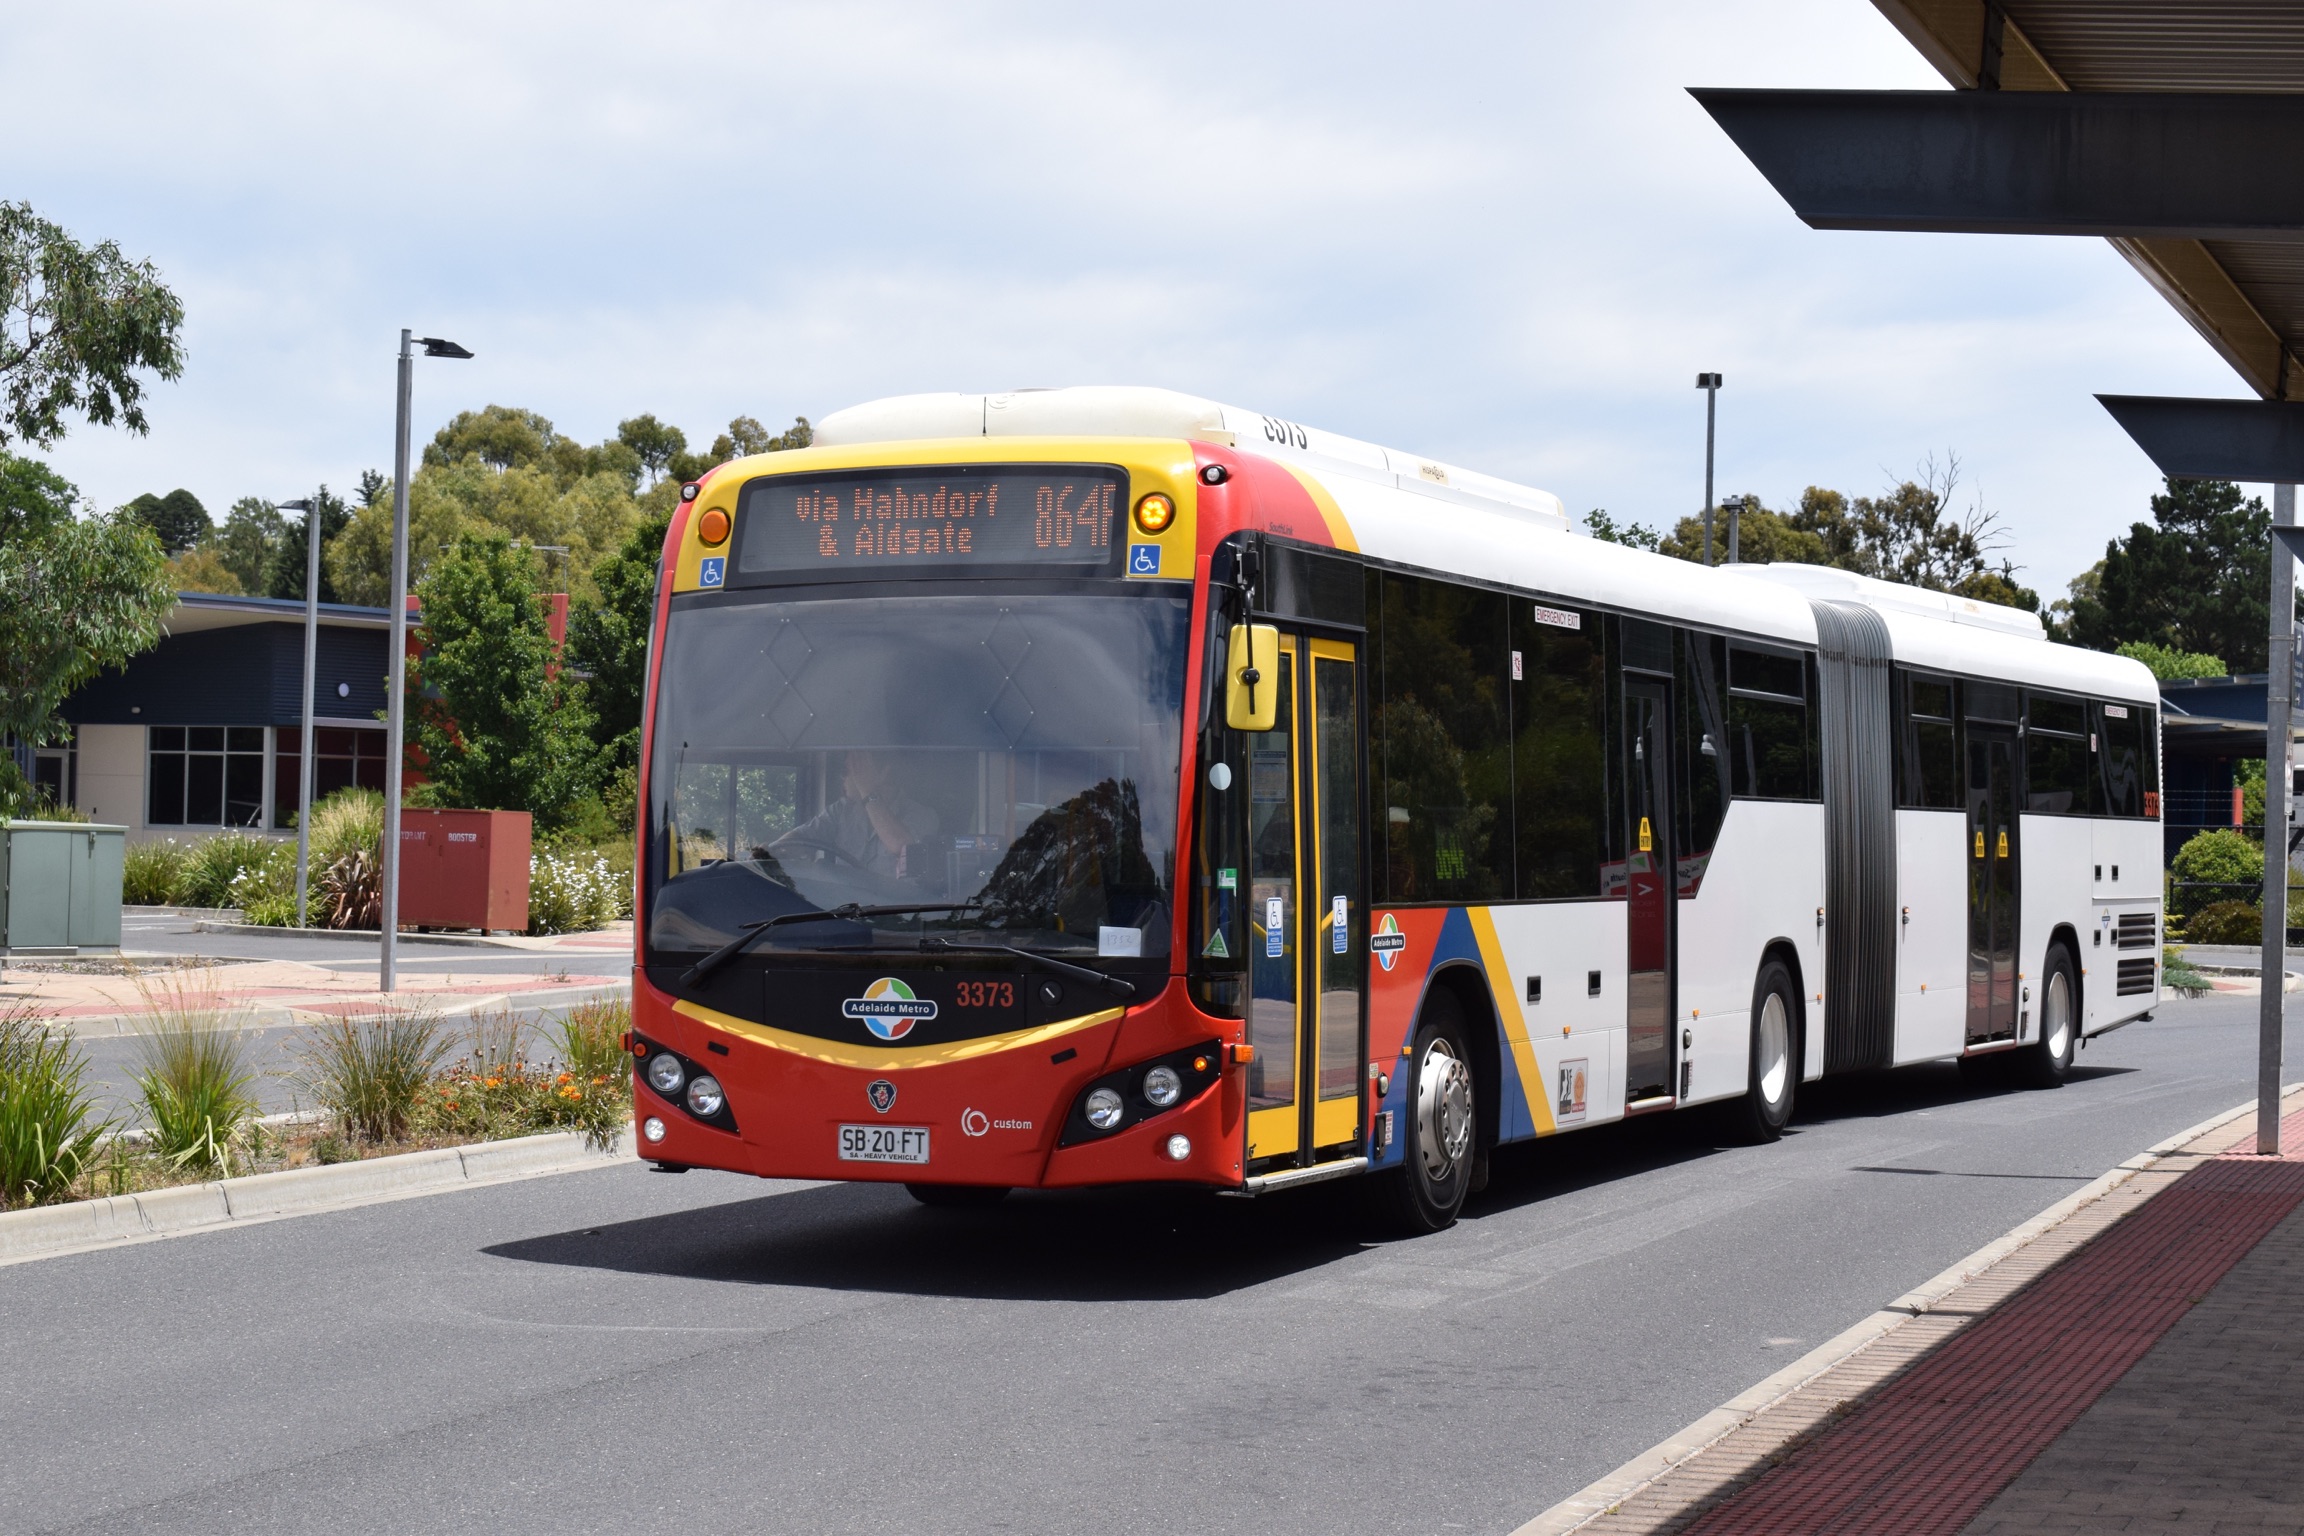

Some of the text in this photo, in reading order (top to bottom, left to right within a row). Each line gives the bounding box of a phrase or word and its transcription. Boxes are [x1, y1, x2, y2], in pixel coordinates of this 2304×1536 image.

[796, 483, 998, 522] via Hahndorf
[1034, 483, 1117, 548] 864F
[818, 521, 973, 557] & Aldgate
[1536, 608, 1579, 628] EMERGENCY EXIT
[2144, 791, 2160, 817] 3373
[400, 831, 477, 842] YDRANT BOOSTER
[1373, 938, 1403, 948] Adelaide Metro
[956, 981, 1014, 1008] 3373
[851, 1003, 930, 1014] Adelaide Metro
[993, 1119, 1032, 1130] custom
